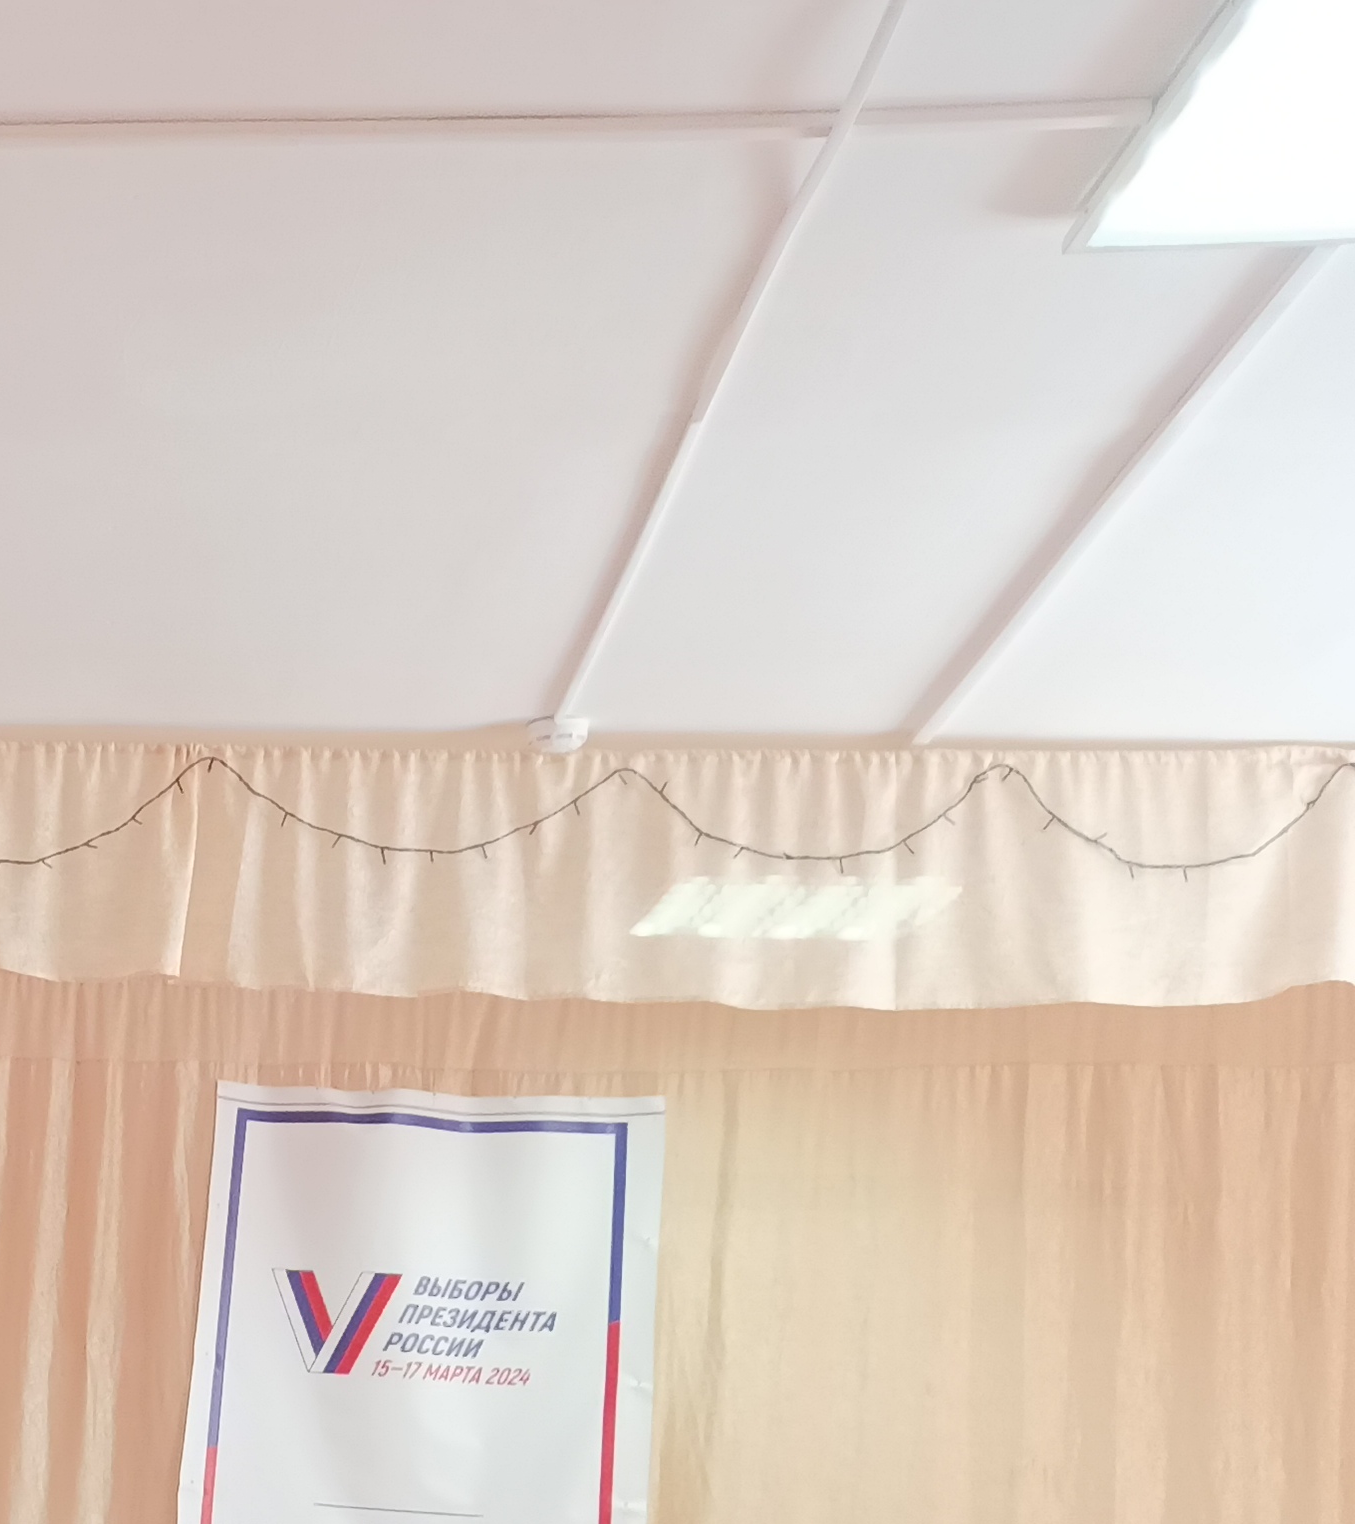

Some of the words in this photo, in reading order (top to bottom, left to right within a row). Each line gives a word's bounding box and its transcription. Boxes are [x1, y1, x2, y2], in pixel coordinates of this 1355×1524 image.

[412, 1275, 525, 1302] ВЫБОРЫ
[398, 1303, 557, 1333] ПРЕЗИДЕНТА
[382, 1332, 484, 1359] РОССИИ
[422, 1362, 483, 1384] МАРТА
[484, 1366, 531, 1387] 2024
